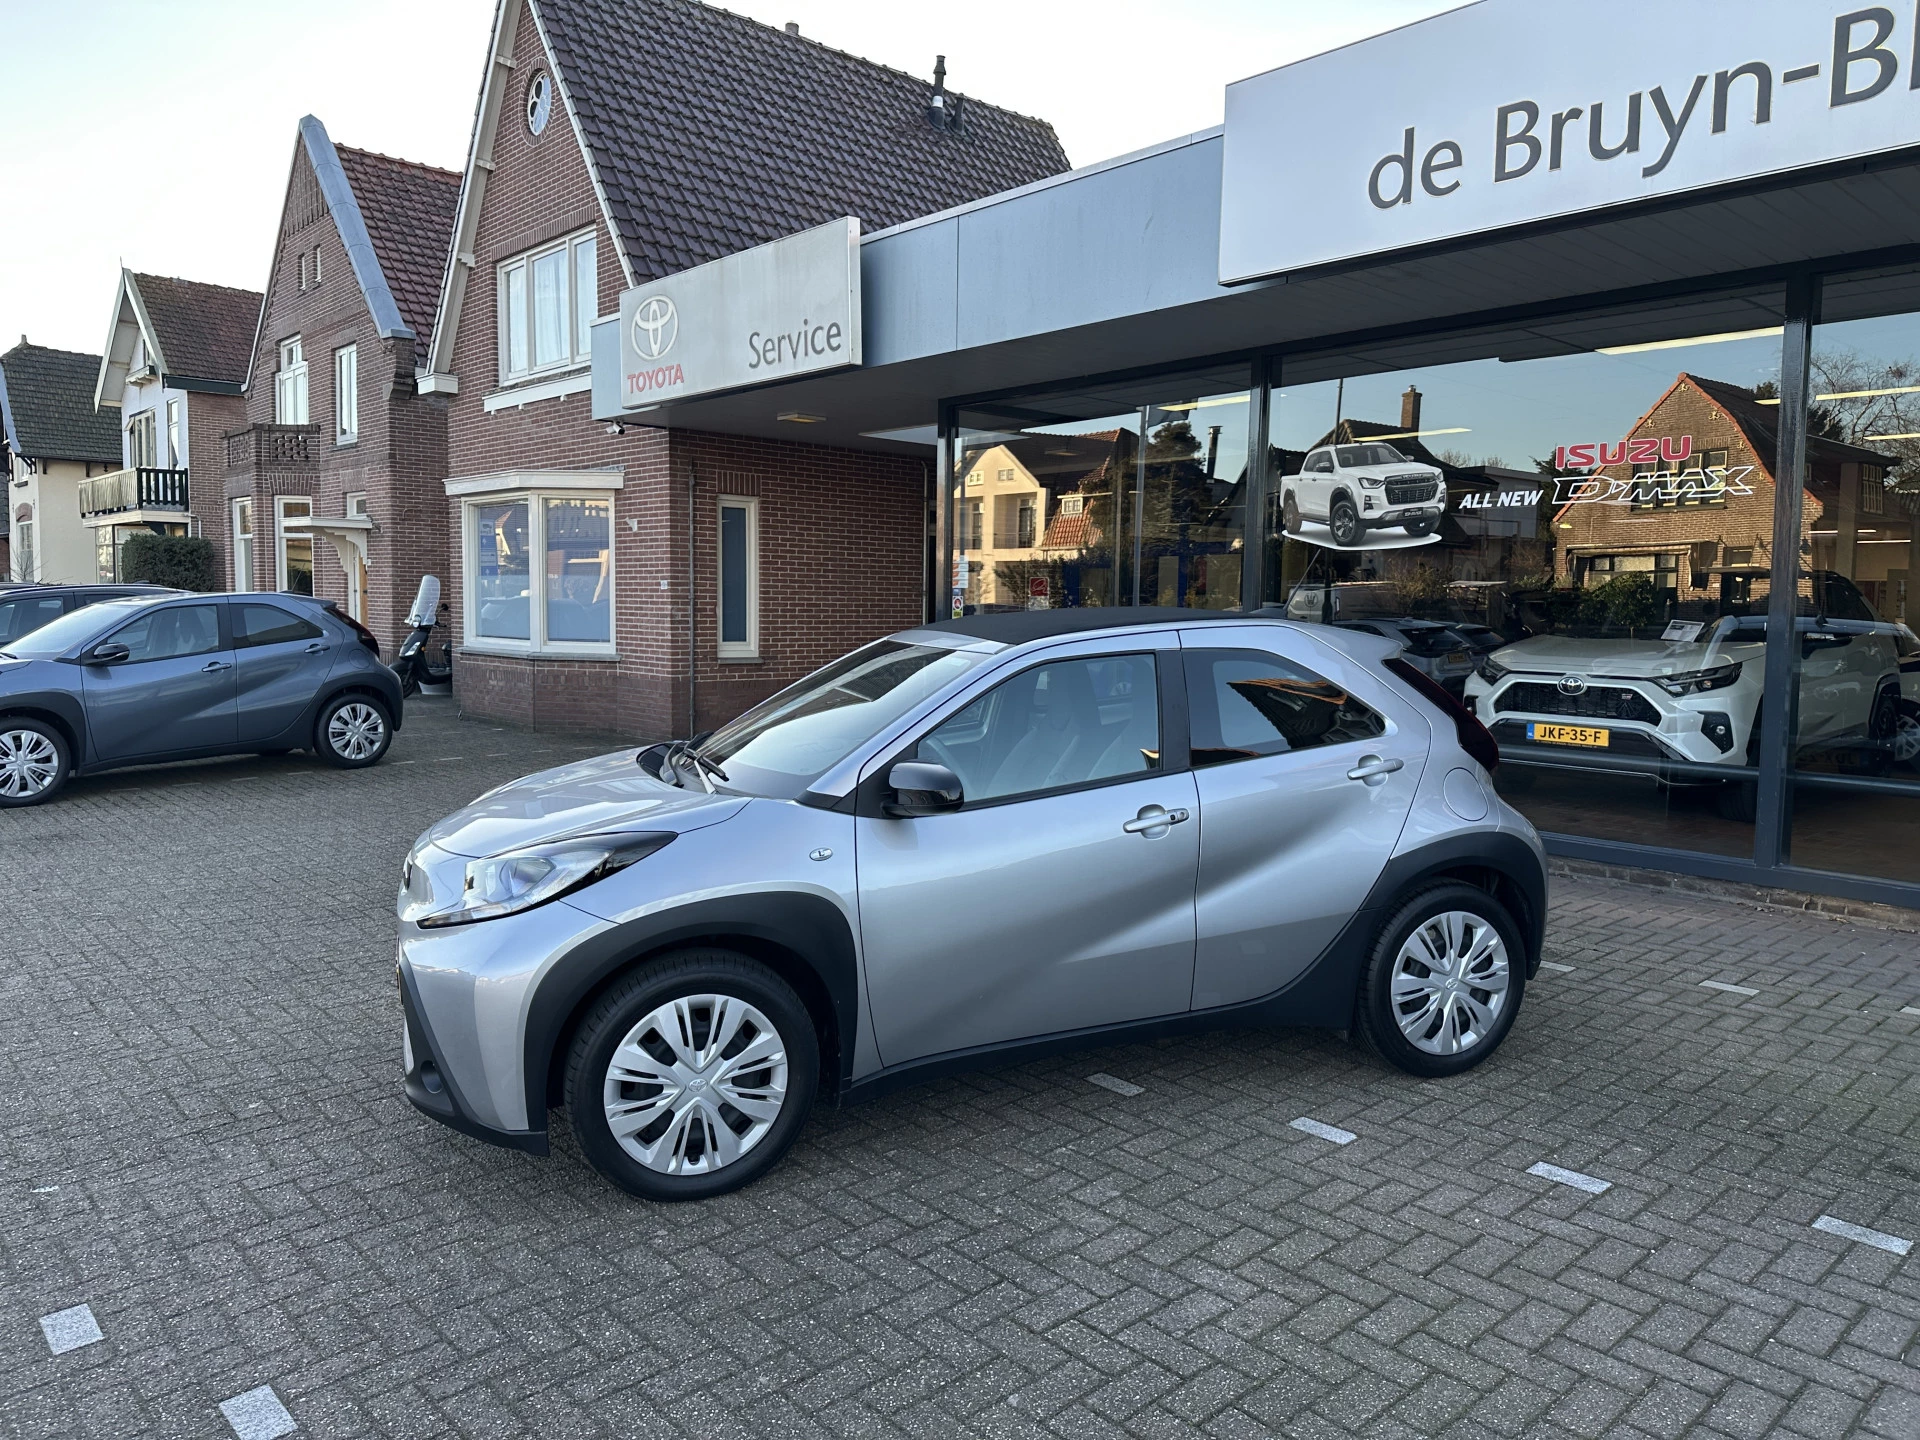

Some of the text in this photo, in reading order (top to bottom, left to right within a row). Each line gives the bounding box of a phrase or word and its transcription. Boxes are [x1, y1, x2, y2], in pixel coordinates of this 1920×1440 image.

[1367, 127, 1463, 210] de
[748, 319, 842, 369] Service
[627, 364, 684, 393] TOYOTA
[1555, 435, 1692, 469] ISUZU
[1458, 493, 1492, 509] ALL
[1497, 490, 1544, 507] NEW
[1540, 726, 1601, 743] JKF-35-F
